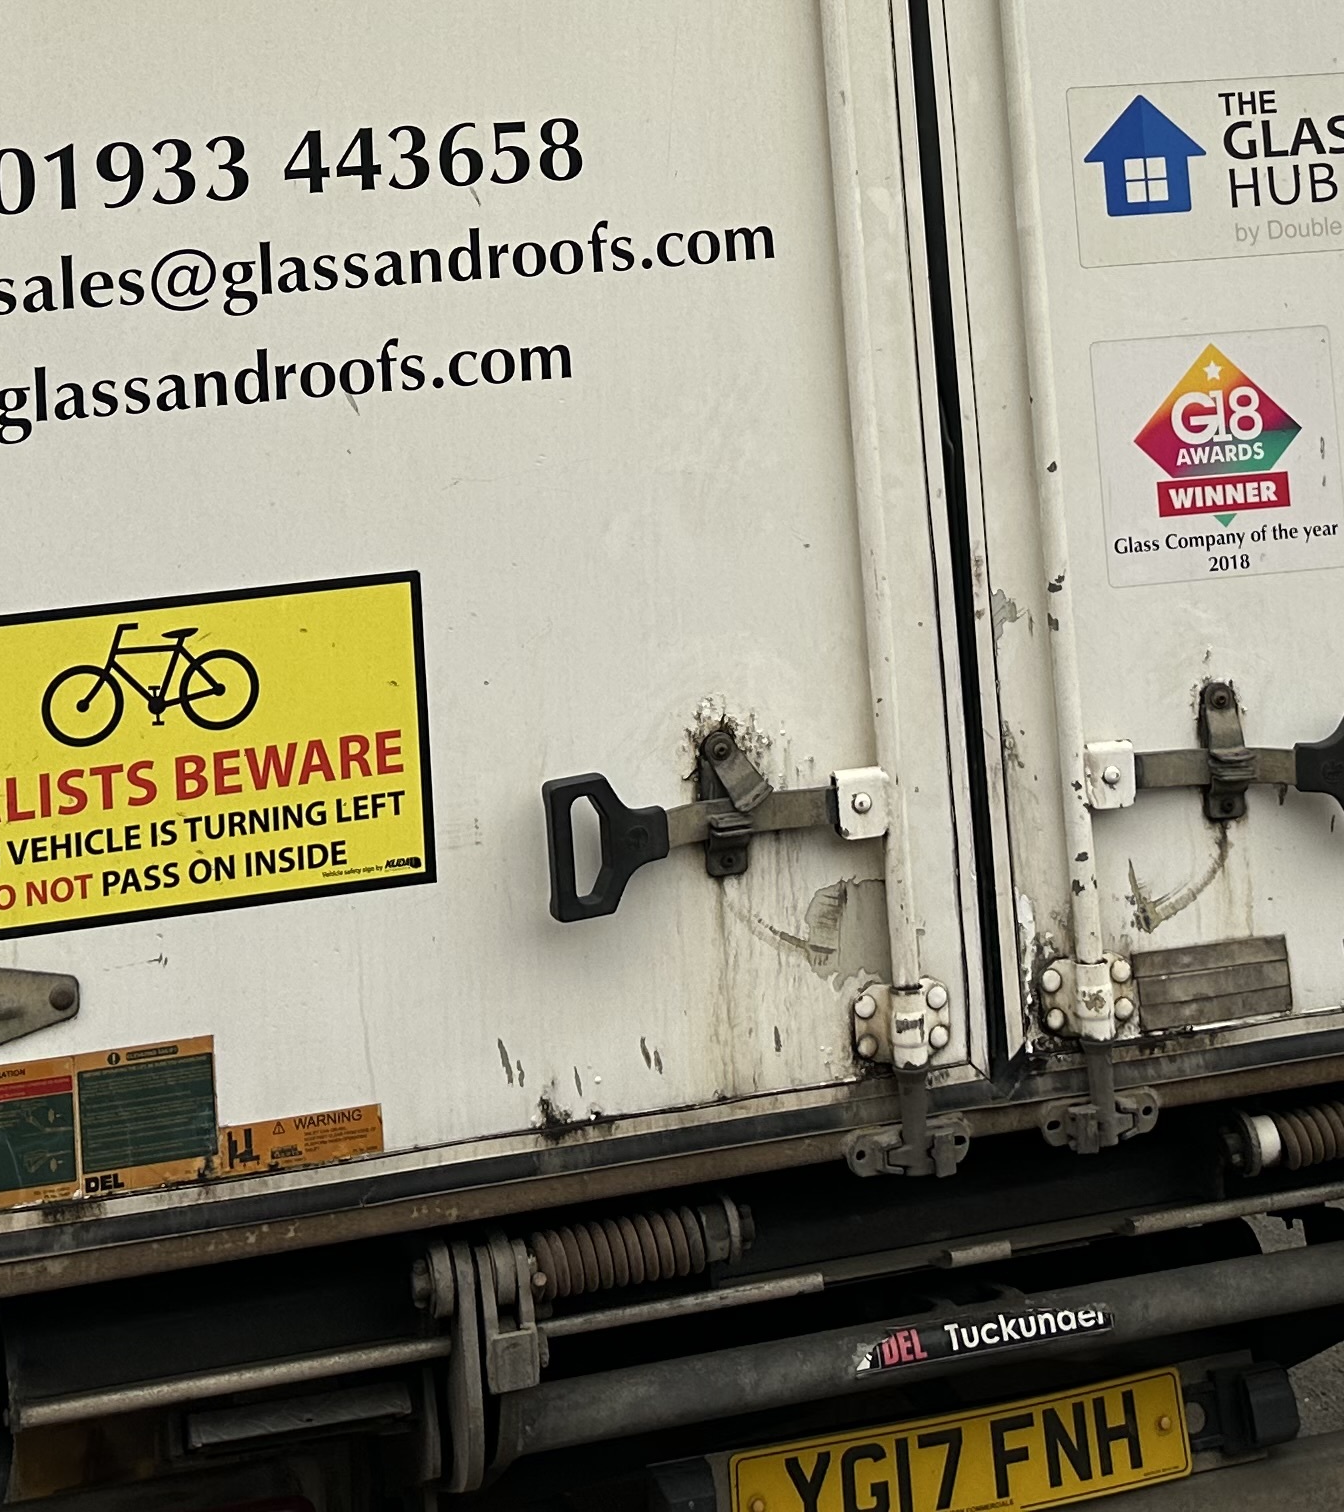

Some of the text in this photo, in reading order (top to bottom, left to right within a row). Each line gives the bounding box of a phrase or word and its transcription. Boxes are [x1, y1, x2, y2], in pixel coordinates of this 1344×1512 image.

[1218, 90, 1277, 117] THE
[283, 116, 584, 195] 443658
[1229, 163, 1339, 209] HUB
[1235, 223, 1262, 247] by
[1268, 217, 1343, 241] Double
[1176, 442, 1264, 466] AWARDS
[1168, 480, 1278, 509] WINNER
[1114, 523, 1339, 554] Glass Company of the year
[1208, 554, 1250, 572] 2018
[174, 729, 405, 802] BEWARE
[6, 824, 141, 866] VEHICLE
[150, 818, 177, 848] IS
[183, 800, 327, 842] TURNING
[336, 790, 406, 824] LEFT
[25, 873, 93, 908] NOT
[102, 861, 180, 898] PASS
[188, 854, 236, 885] ON
[244, 840, 348, 878] INSIDE
[294, 1109, 363, 1131] WARNING
[85, 1173, 125, 1193] DEL
[882, 1328, 928, 1367] DEL
[784, 1389, 1144, 1512] YG17 FNH
